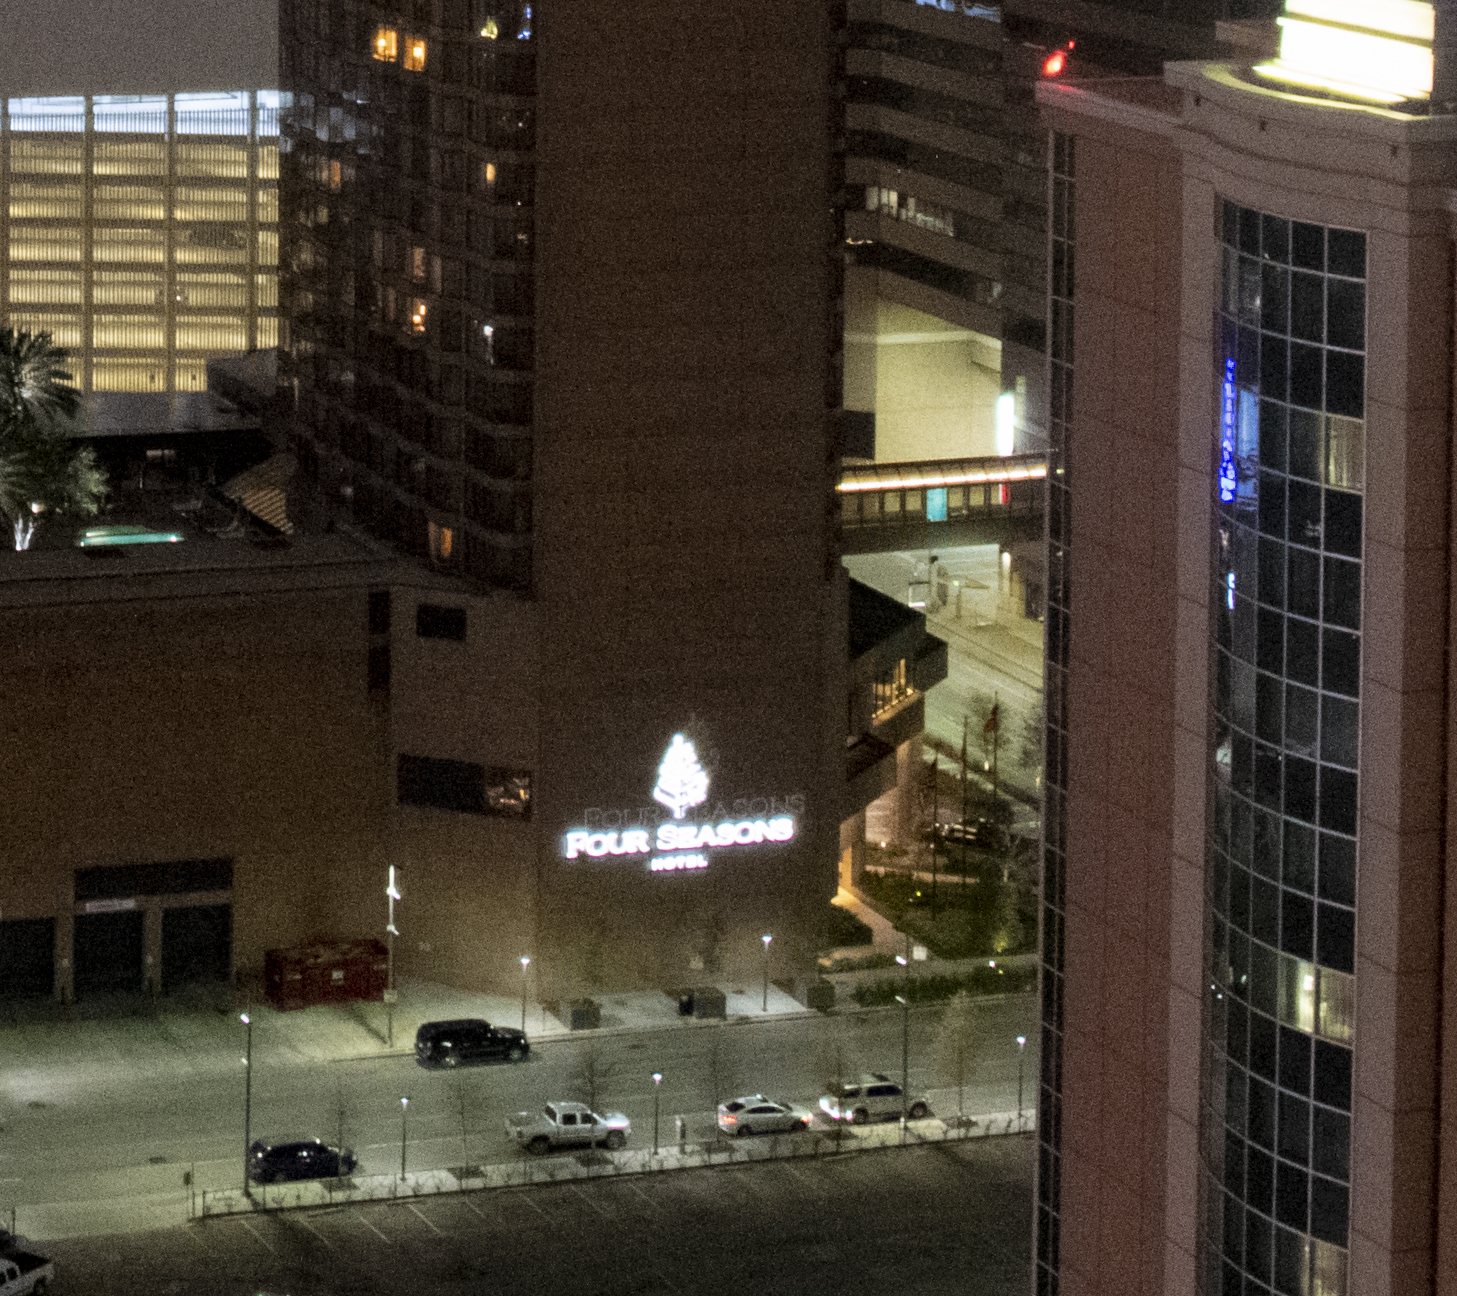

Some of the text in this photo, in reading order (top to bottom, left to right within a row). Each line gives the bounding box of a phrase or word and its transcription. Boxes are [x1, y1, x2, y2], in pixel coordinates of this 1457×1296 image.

[565, 817, 794, 859] FOUR SEASONS
[651, 855, 709, 872] HOTEL
